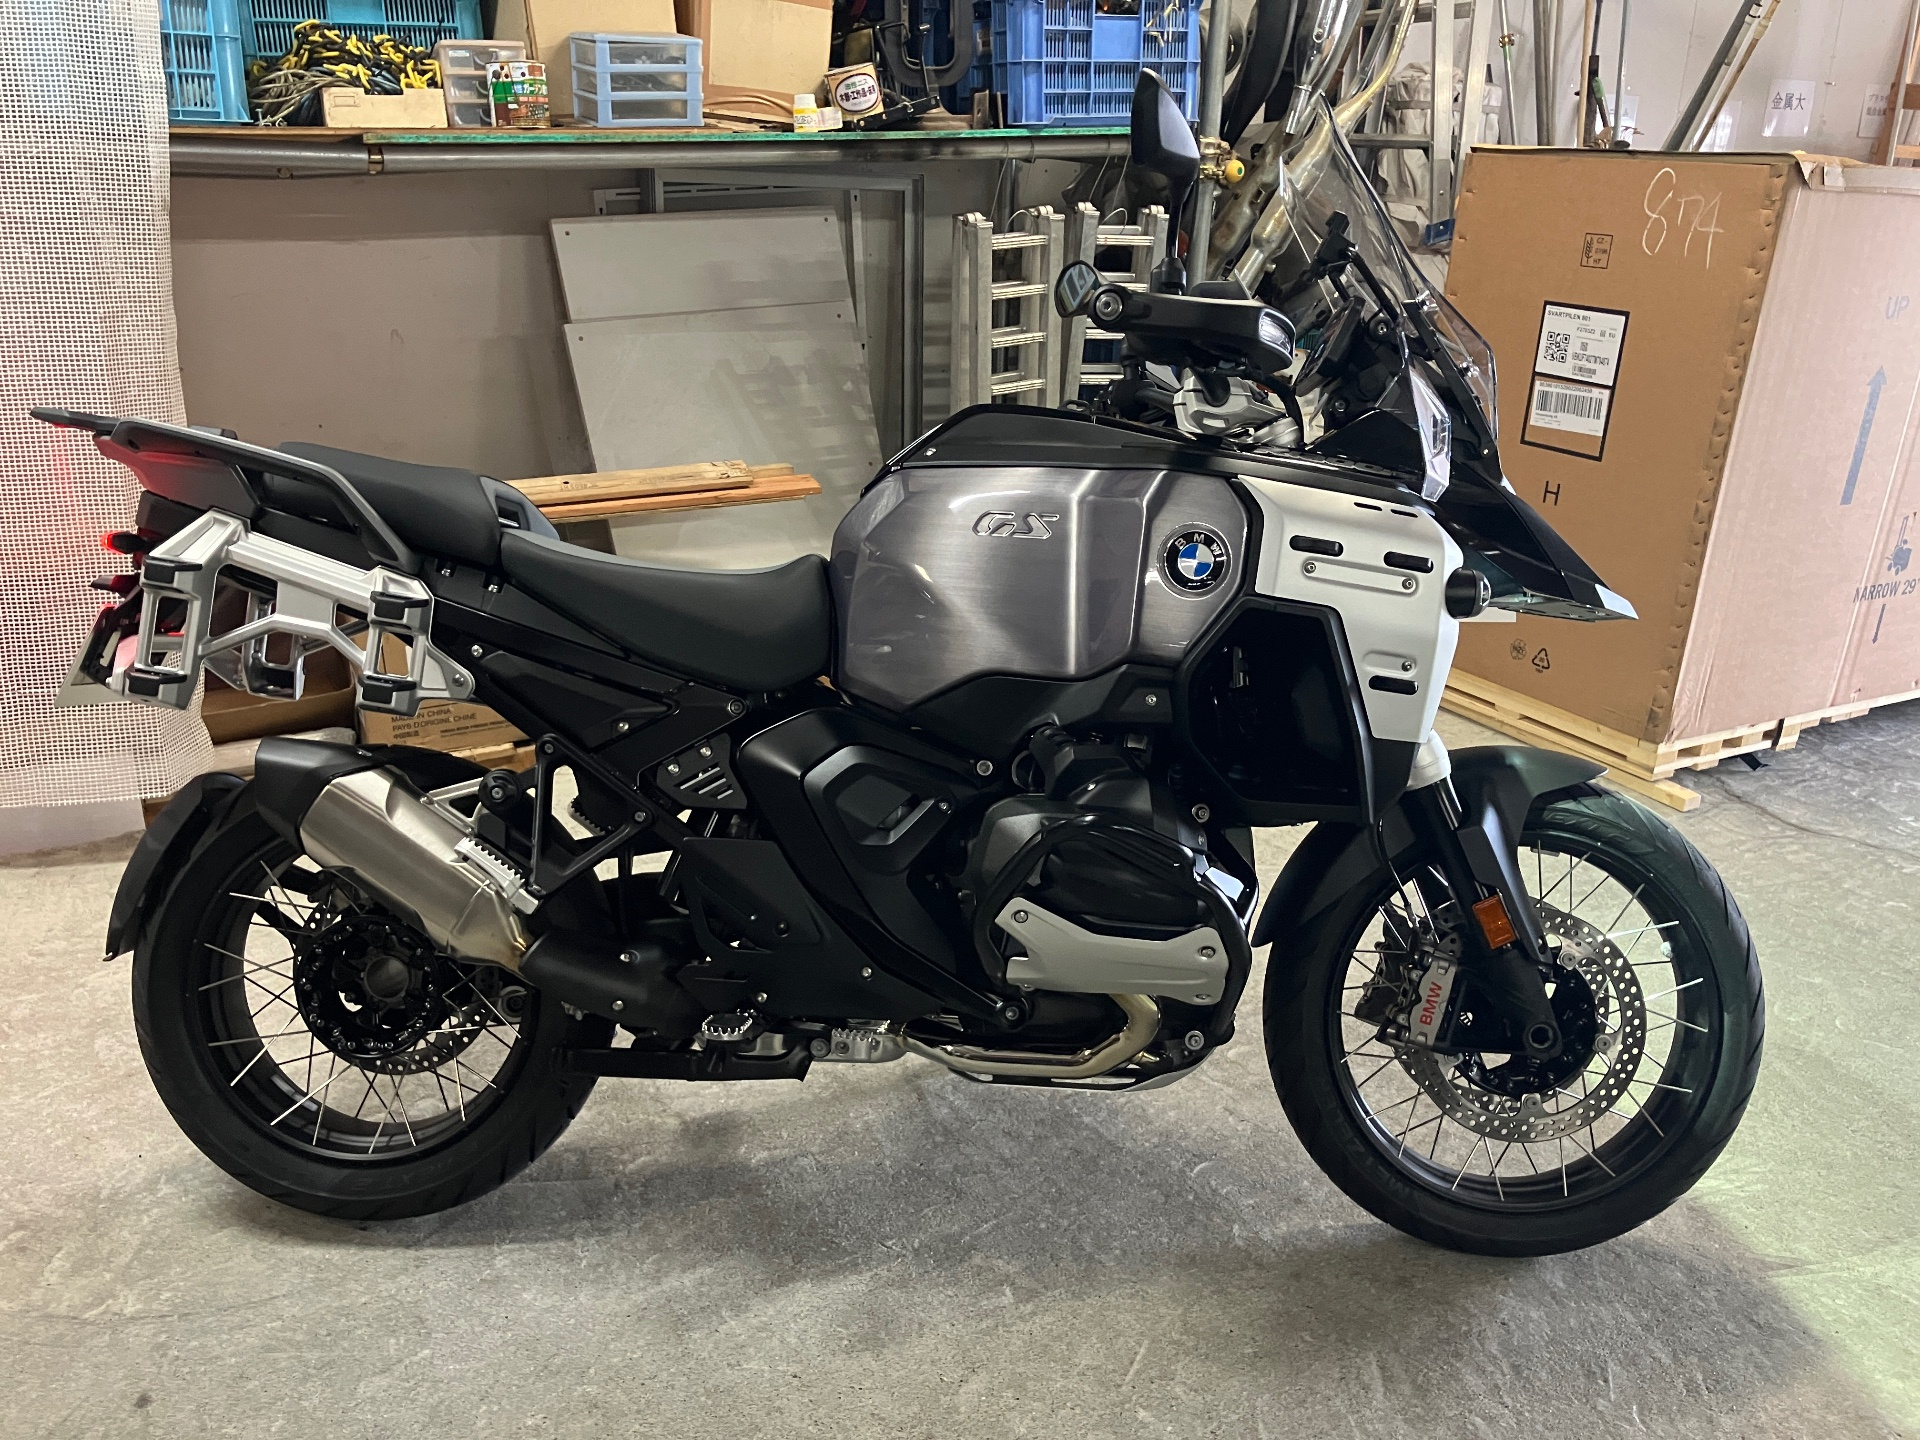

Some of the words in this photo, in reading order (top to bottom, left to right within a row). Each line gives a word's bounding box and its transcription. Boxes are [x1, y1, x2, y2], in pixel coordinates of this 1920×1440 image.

[1771, 91, 1806, 111] 金属大
[1642, 167, 1724, 269] 874
[1547, 310, 1580, 321] SVARTPILEN
[1885, 295, 1910, 320] UP
[1543, 481, 1560, 506] H
[972, 510, 1059, 540] GS
[1175, 532, 1226, 562] BMW
[1853, 581, 1901, 603] NARROW
[393, 723, 412, 732] PAYS
[453, 712, 477, 721] CHINE
[427, 708, 452, 718] CHINA
[1419, 981, 1442, 1026] BMW
